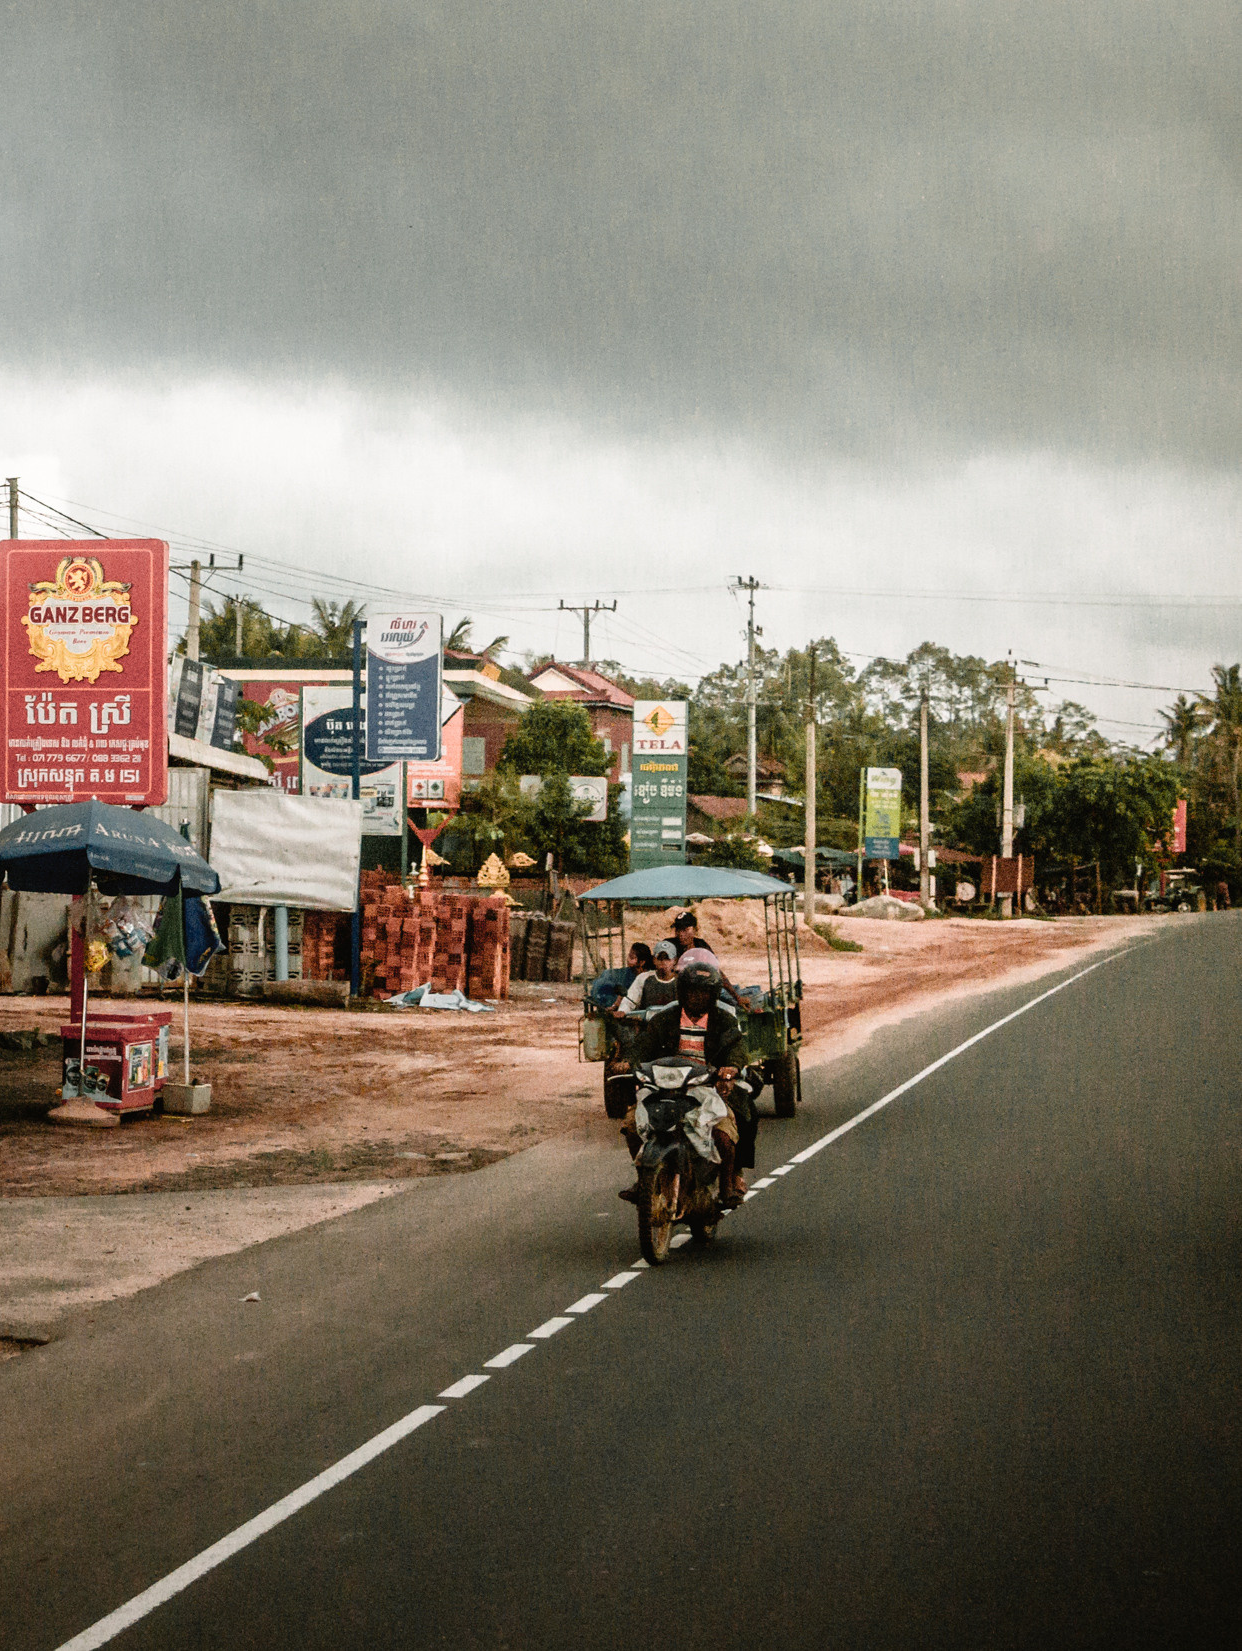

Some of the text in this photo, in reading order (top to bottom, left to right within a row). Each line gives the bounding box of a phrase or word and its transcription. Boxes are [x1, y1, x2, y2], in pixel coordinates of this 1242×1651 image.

[30, 606, 129, 623] GANZBERG
[89, 694, 131, 734] ស្រី
[636, 739, 682, 750] TELA
[16, 754, 26, 762] Tel
[32, 754, 45, 762] 071
[47, 754, 63, 762] 779
[92, 754, 109, 762] 088
